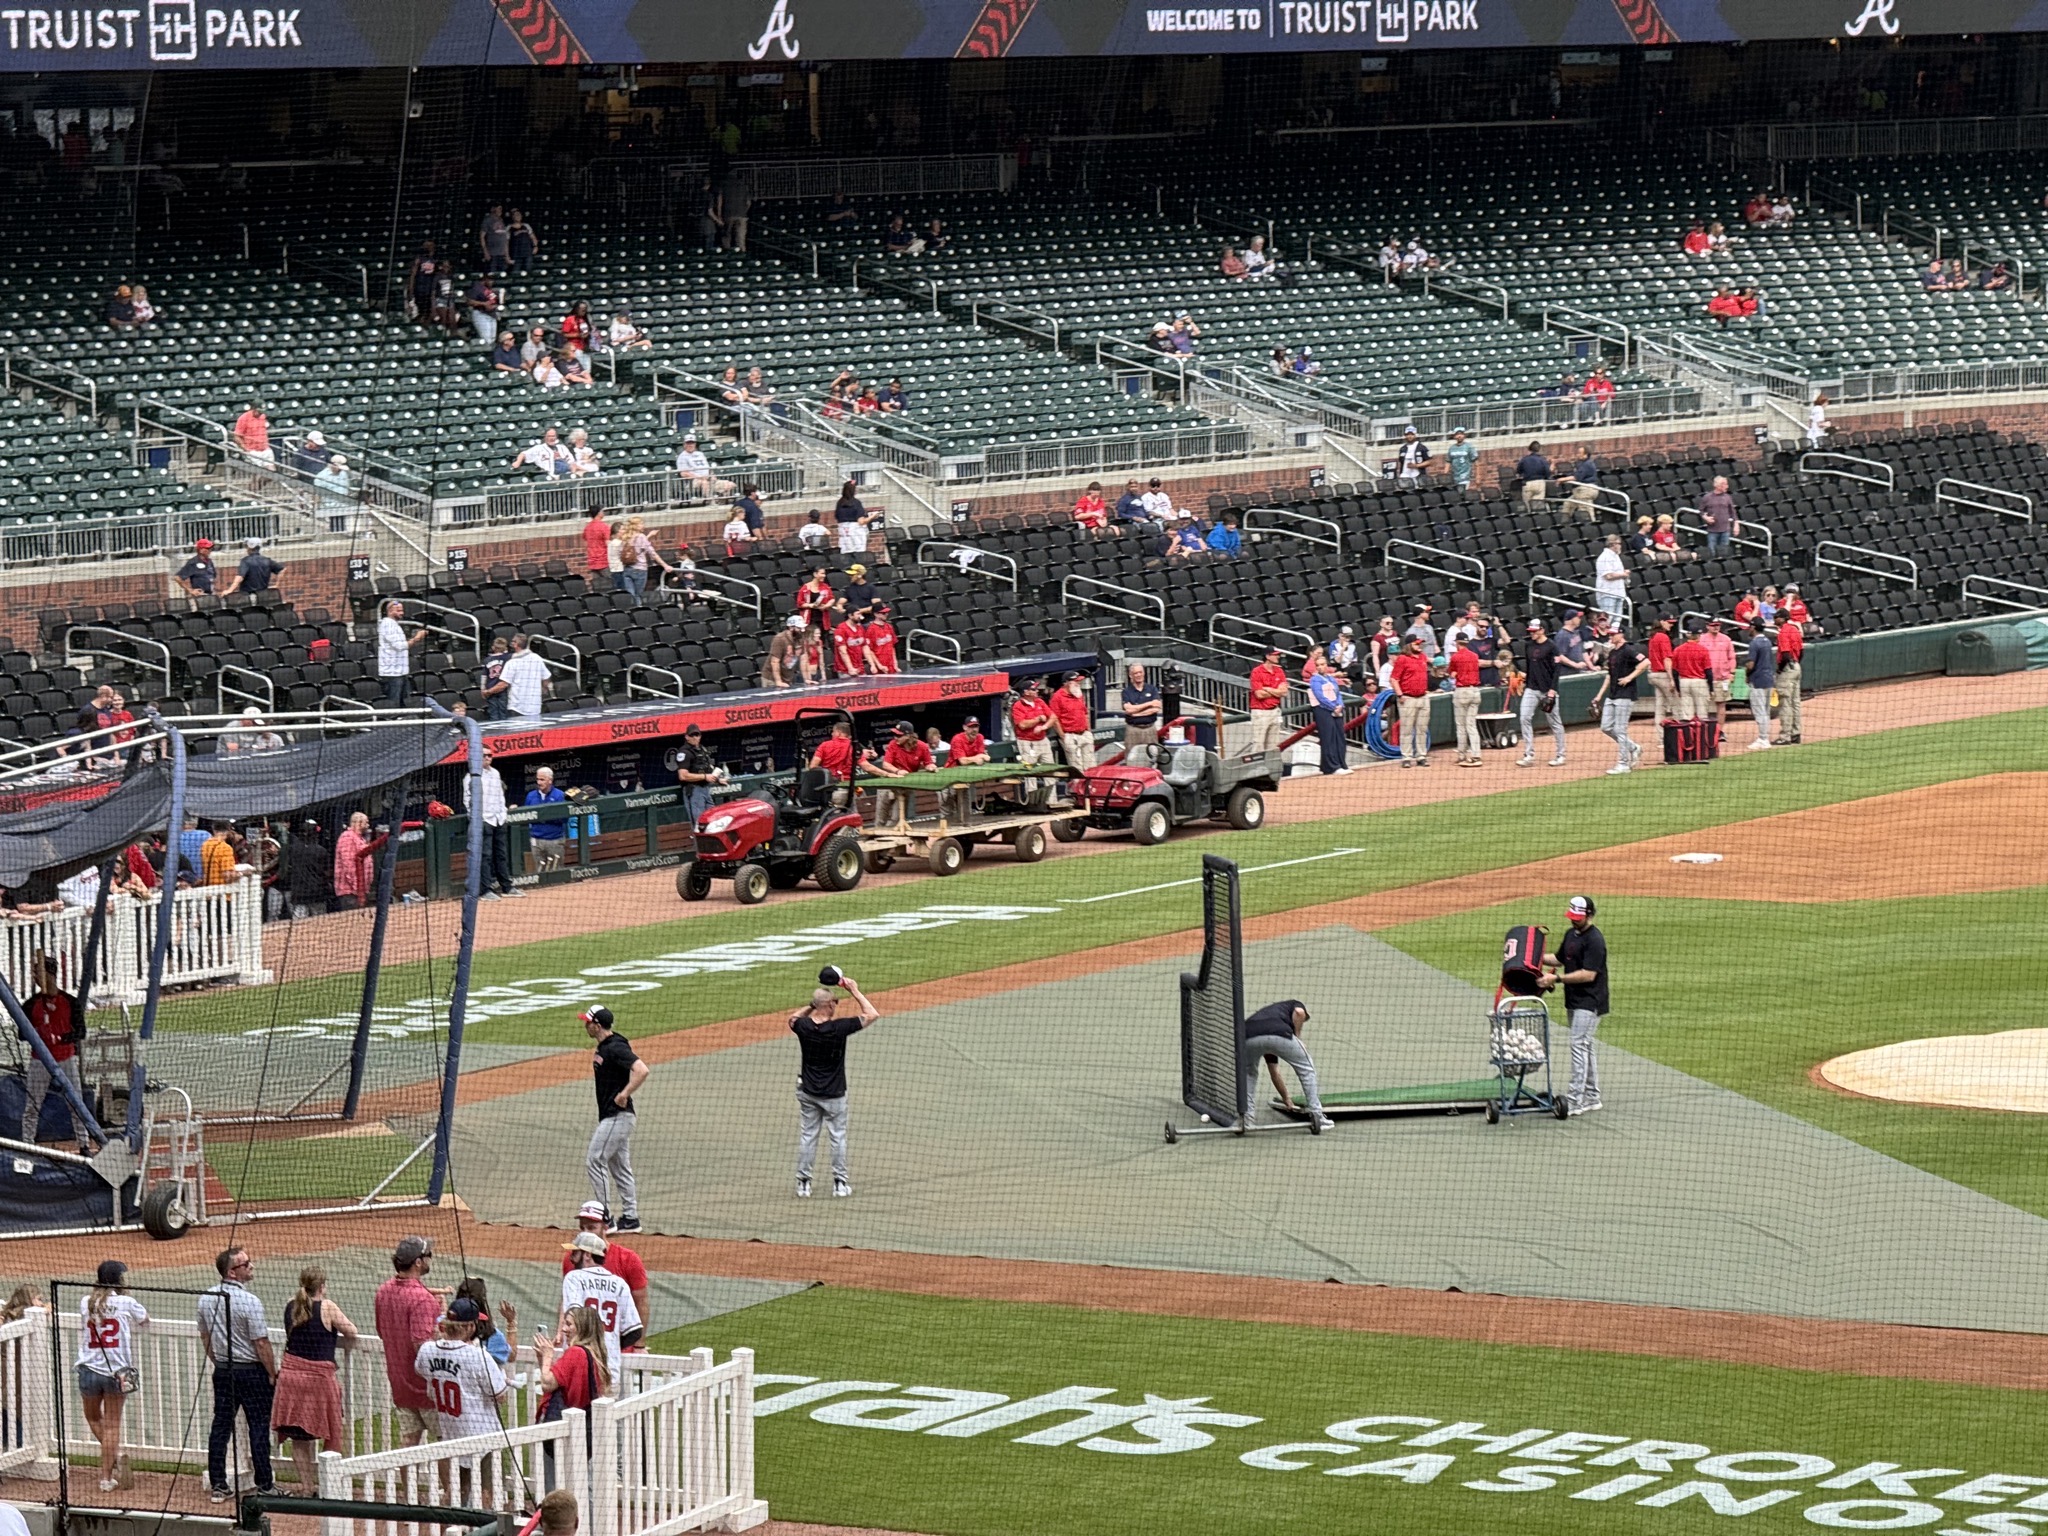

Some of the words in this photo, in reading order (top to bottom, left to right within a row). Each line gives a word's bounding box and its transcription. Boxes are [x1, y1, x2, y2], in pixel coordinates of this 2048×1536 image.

[1146, 9, 1230, 32] WELCOME
[1233, 9, 1262, 31] TO
[1278, 1, 1372, 34] TRUIST
[1413, 0, 1480, 31] PARK
[1, 9, 141, 49] TRUIST
[205, 9, 302, 47] PARK
[940, 678, 985, 697] SEATGEEK
[835, 690, 881, 709] SEATGEEK
[725, 705, 773, 724] SEATGEEK
[611, 719, 661, 739] SEATGEEK
[493, 734, 544, 754] SEATGEEK
[567, 803, 598, 816] Tractors
[623, 792, 678, 808] YanmarUS.com
[625, 854, 680, 869] YanmarUS.com
[570, 867, 600, 879] Tractors
[580, 1279, 617, 1294] HARRIS
[86, 1318, 120, 1349] 12
[428, 1357, 461, 1377] JONES
[432, 1378, 463, 1418] 10
